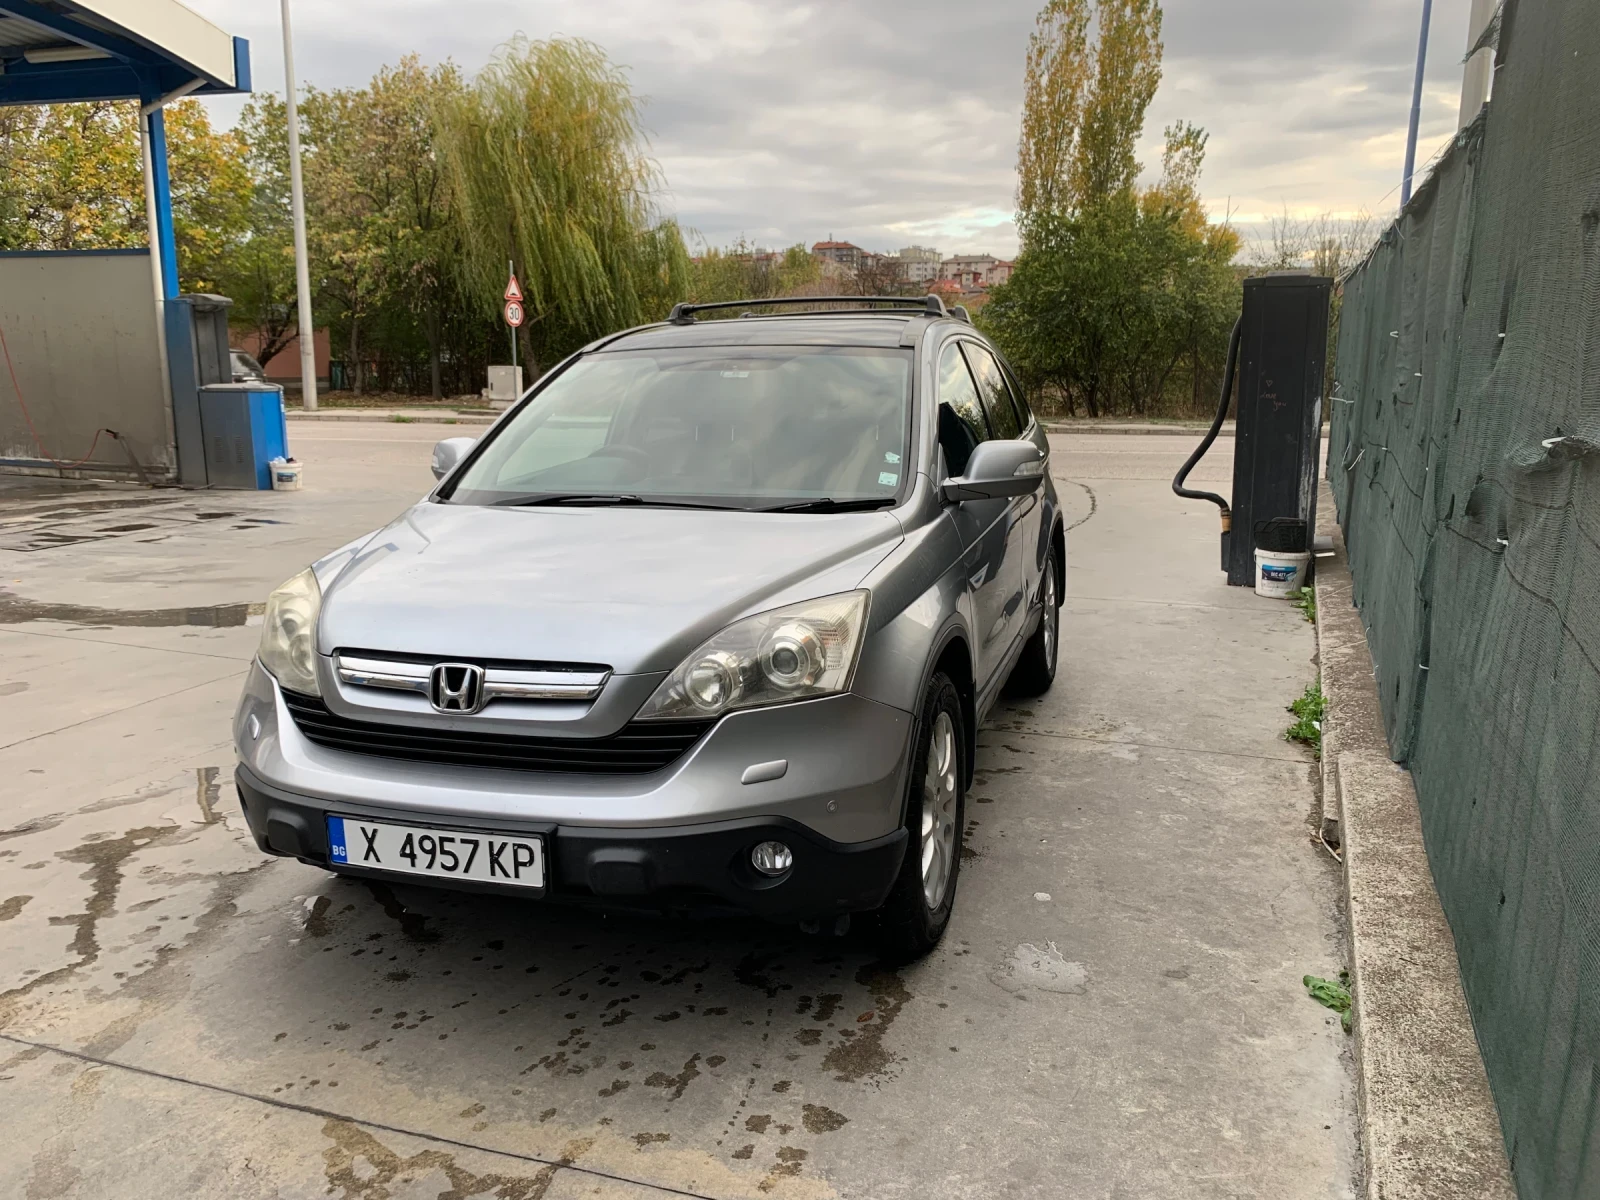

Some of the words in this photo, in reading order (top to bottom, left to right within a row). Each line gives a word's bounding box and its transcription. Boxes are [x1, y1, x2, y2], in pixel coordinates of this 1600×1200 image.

[509, 307, 520, 321] 30
[332, 845, 346, 857] BG
[360, 826, 382, 863] X
[399, 832, 480, 873] 4957
[488, 840, 535, 879] KP
